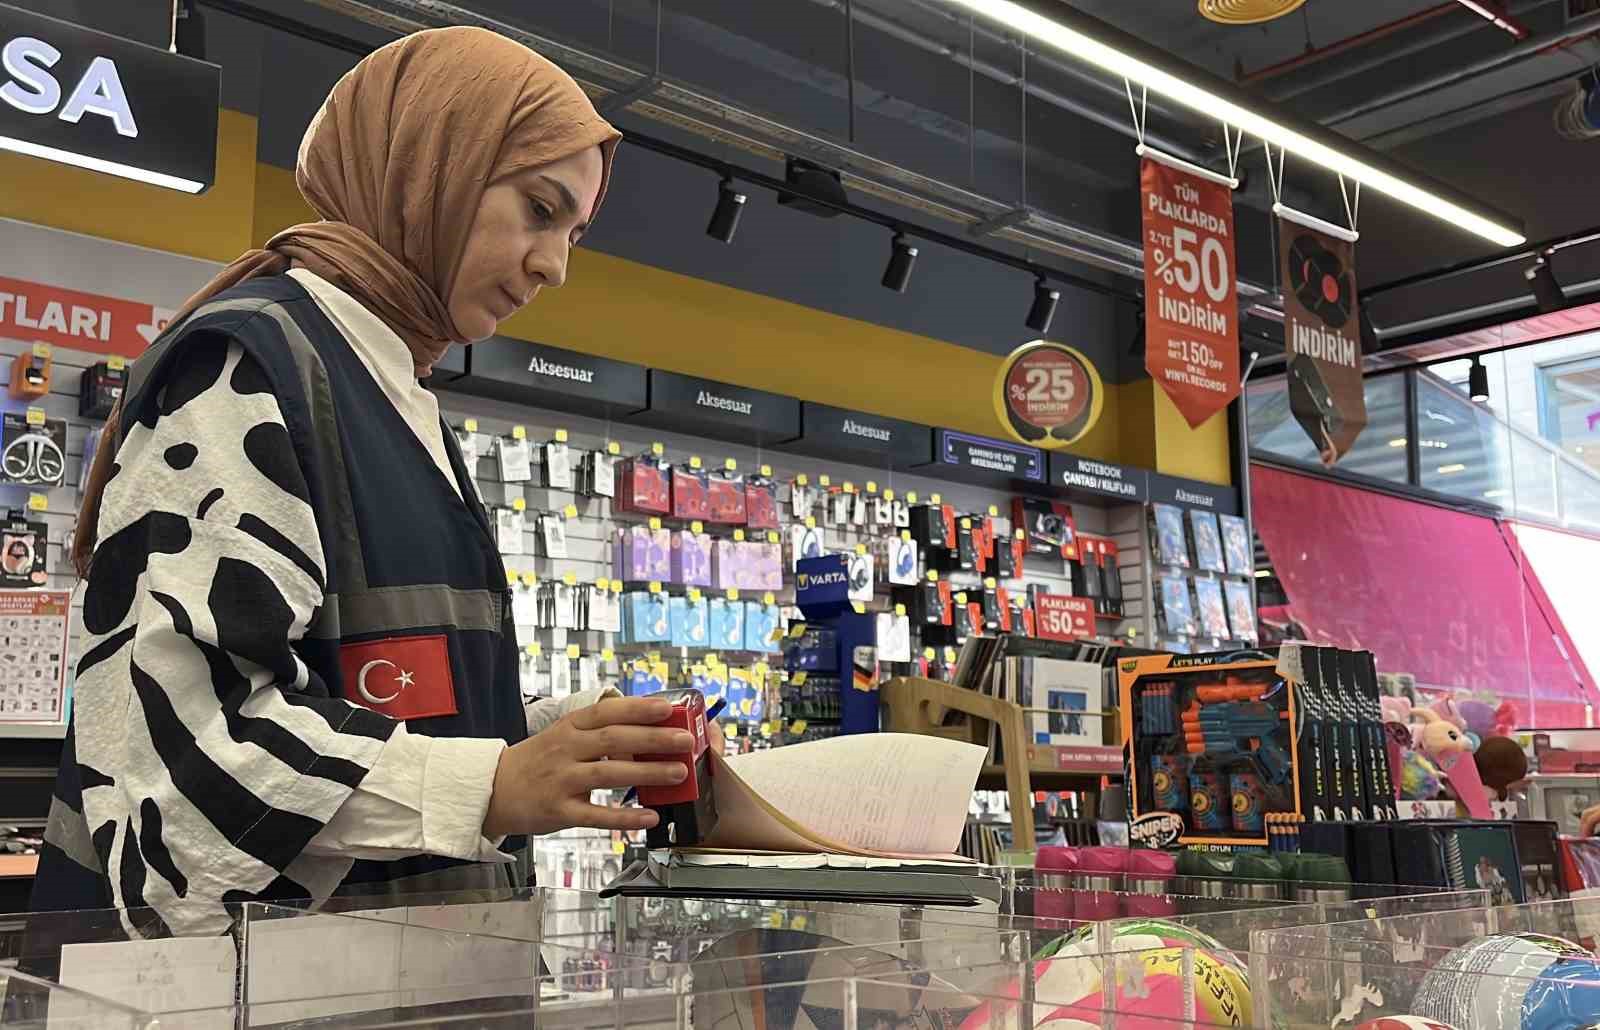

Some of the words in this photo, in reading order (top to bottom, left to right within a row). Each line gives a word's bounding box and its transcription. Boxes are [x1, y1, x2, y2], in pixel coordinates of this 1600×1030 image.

[0, 36, 138, 138] SA
[1149, 193, 1228, 236] PLAKLARDA
[1158, 289, 1227, 336] İNDİRİM
[1292, 317, 1356, 368] İNDİRİM
[528, 356, 594, 383] Aksesuar
[1165, 368, 1190, 384] VINYL
[1190, 374, 1227, 393] RECORDS
[696, 391, 752, 415] Aksesuar
[842, 419, 891, 441] Aksesuar
[1063, 471, 1097, 489] ÇANTASI
[1078, 460, 1122, 479] NOTEBOOK
[1175, 488, 1213, 507] Aksesuar
[809, 572, 848, 585] VARTA
[1041, 597, 1087, 612] PLAKLARDA
[1130, 814, 1181, 840] SNIPER
